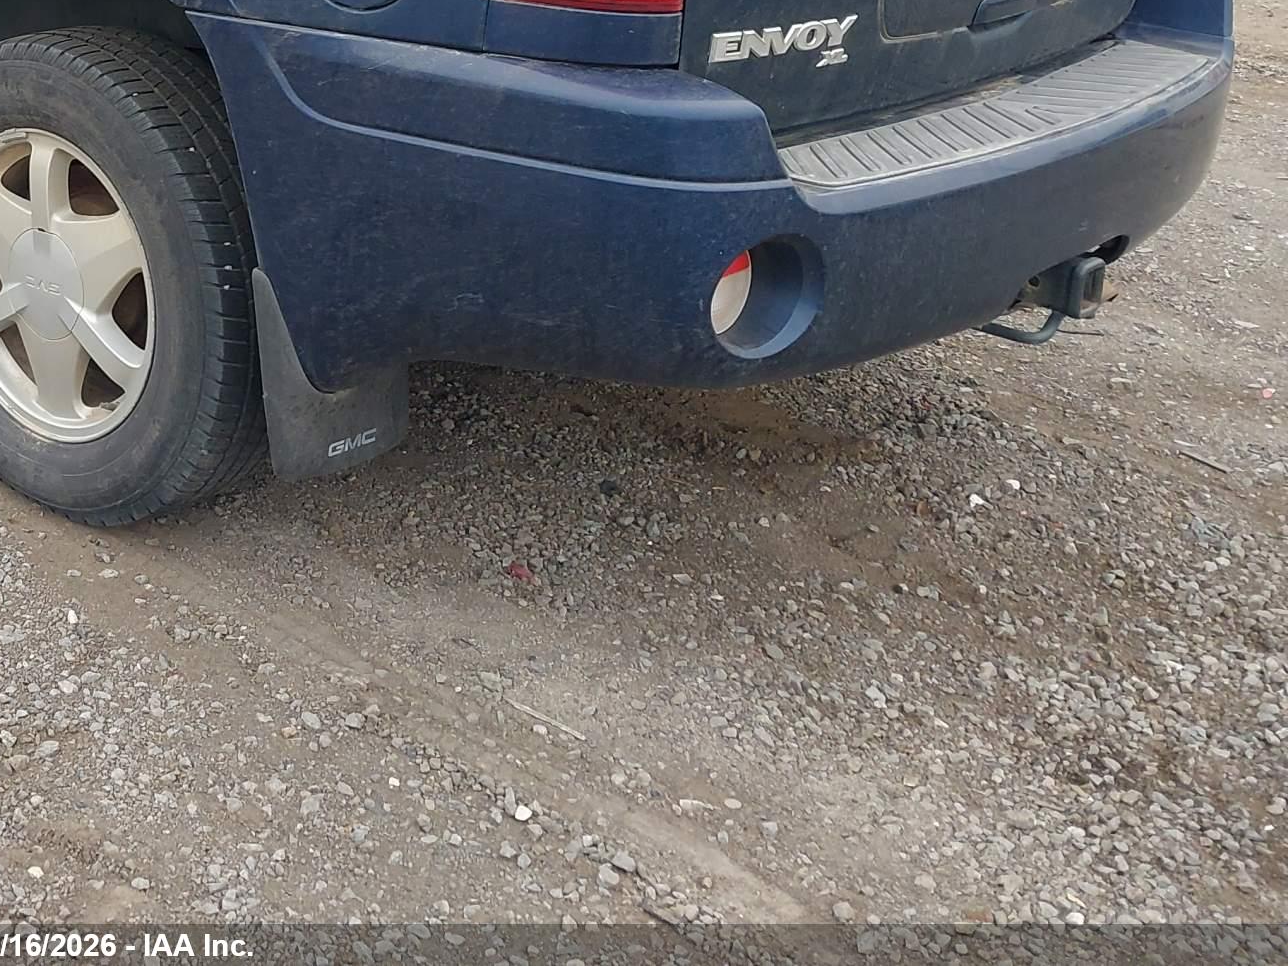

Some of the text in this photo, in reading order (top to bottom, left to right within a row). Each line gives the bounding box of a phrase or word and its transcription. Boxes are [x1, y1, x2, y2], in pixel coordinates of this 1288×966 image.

[708, 13, 859, 64] ENVOY
[815, 47, 849, 68] XL
[327, 427, 377, 458] GMC
